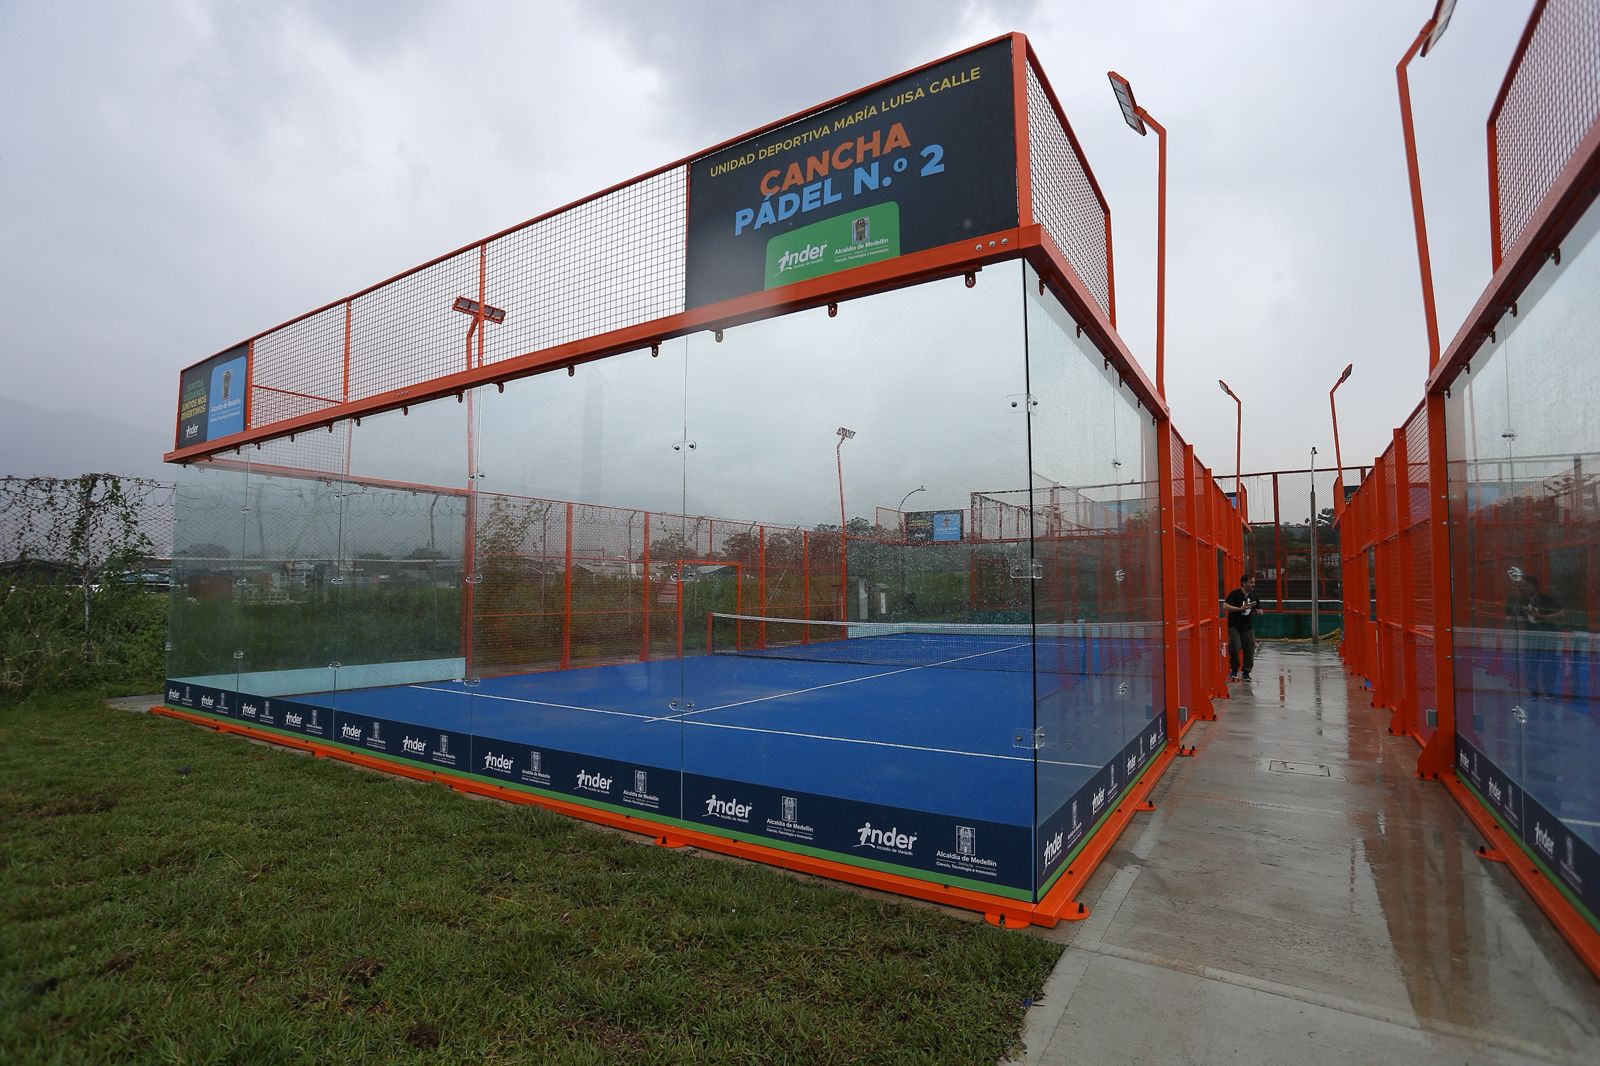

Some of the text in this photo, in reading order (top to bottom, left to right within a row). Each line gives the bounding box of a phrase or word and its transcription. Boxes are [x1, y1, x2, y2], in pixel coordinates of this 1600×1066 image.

[710, 66, 981, 177] UNIDAD DEPORTIVA MARÍA LUISA CALLE
[760, 122, 911, 197] CANCHA
[734, 178, 843, 237] PÁDEL
[919, 143, 945, 177] 2
[778, 242, 828, 272] inder
[285, 711, 303, 725] inder
[342, 722, 362, 738] inder
[402, 735, 427, 752] inder
[484, 751, 514, 770] inder
[576, 769, 613, 791] inder
[705, 794, 753, 818] inder
[857, 822, 918, 850] inder
[1044, 832, 1063, 868] inder
[1535, 821, 1555, 854] inder
